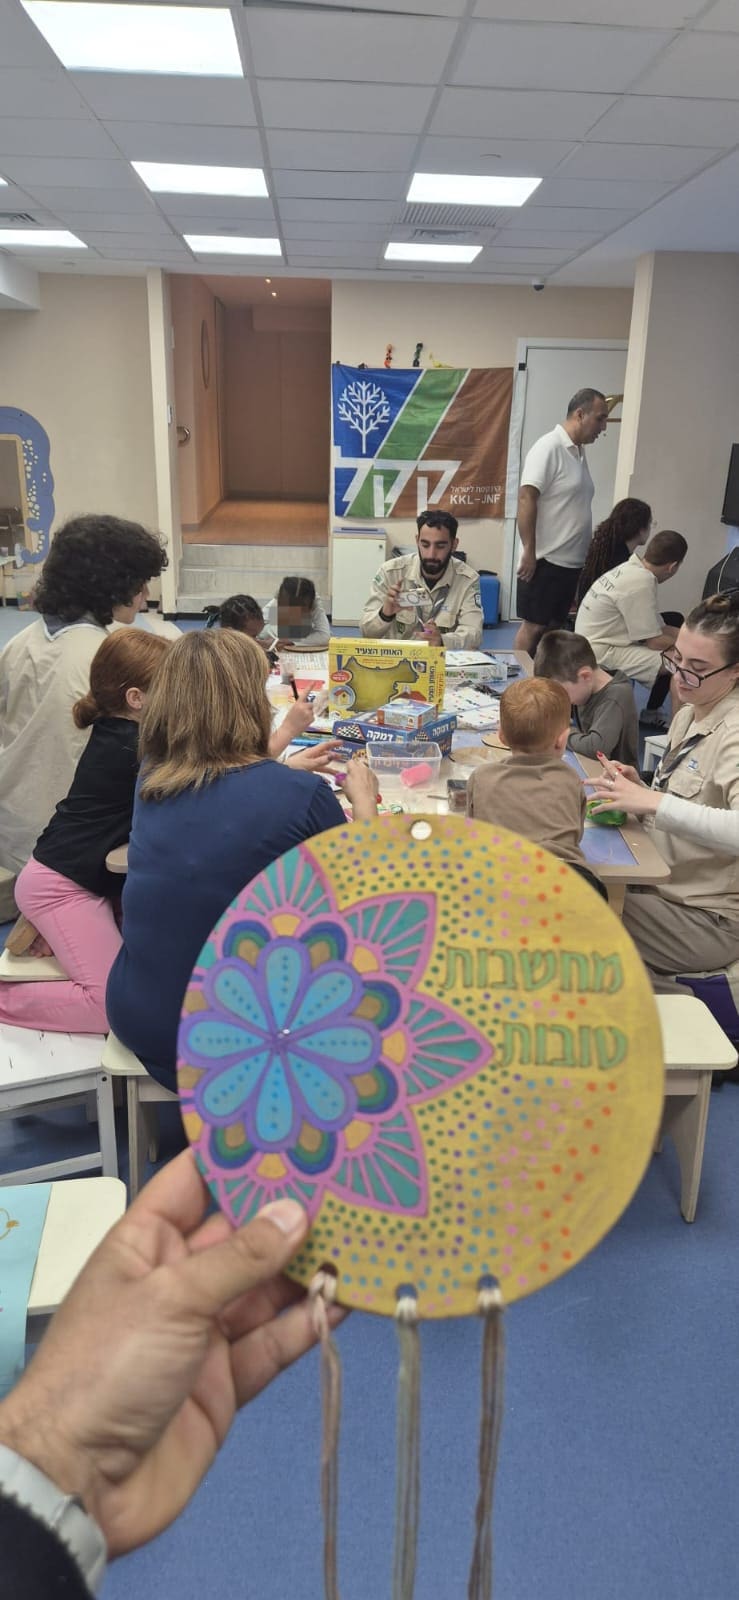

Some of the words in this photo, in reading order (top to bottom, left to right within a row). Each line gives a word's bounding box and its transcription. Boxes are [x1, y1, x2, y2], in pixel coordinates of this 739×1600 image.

[333, 446, 462, 518] קקל
[366, 730, 394, 743] דמקה
[432, 723, 449, 737] דמקה
[440, 946, 625, 995] מחשבות
[497, 1021, 629, 1071] טובות
